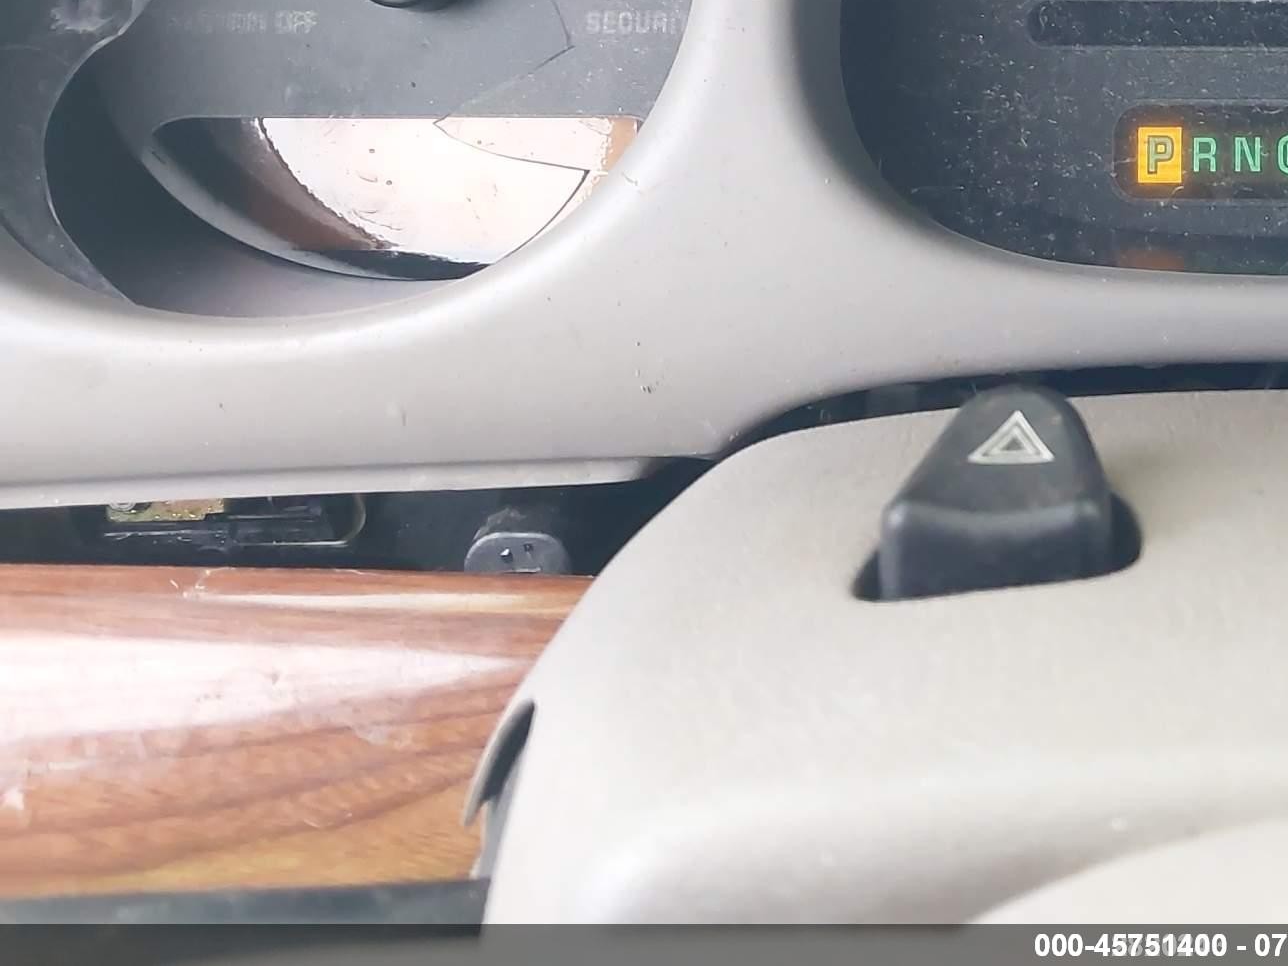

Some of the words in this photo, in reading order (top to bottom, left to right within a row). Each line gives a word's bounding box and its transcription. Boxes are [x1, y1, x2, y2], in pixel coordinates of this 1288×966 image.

[1147, 135, 1174, 175] P
[1192, 136, 1218, 173] R
[1233, 136, 1262, 173] N
